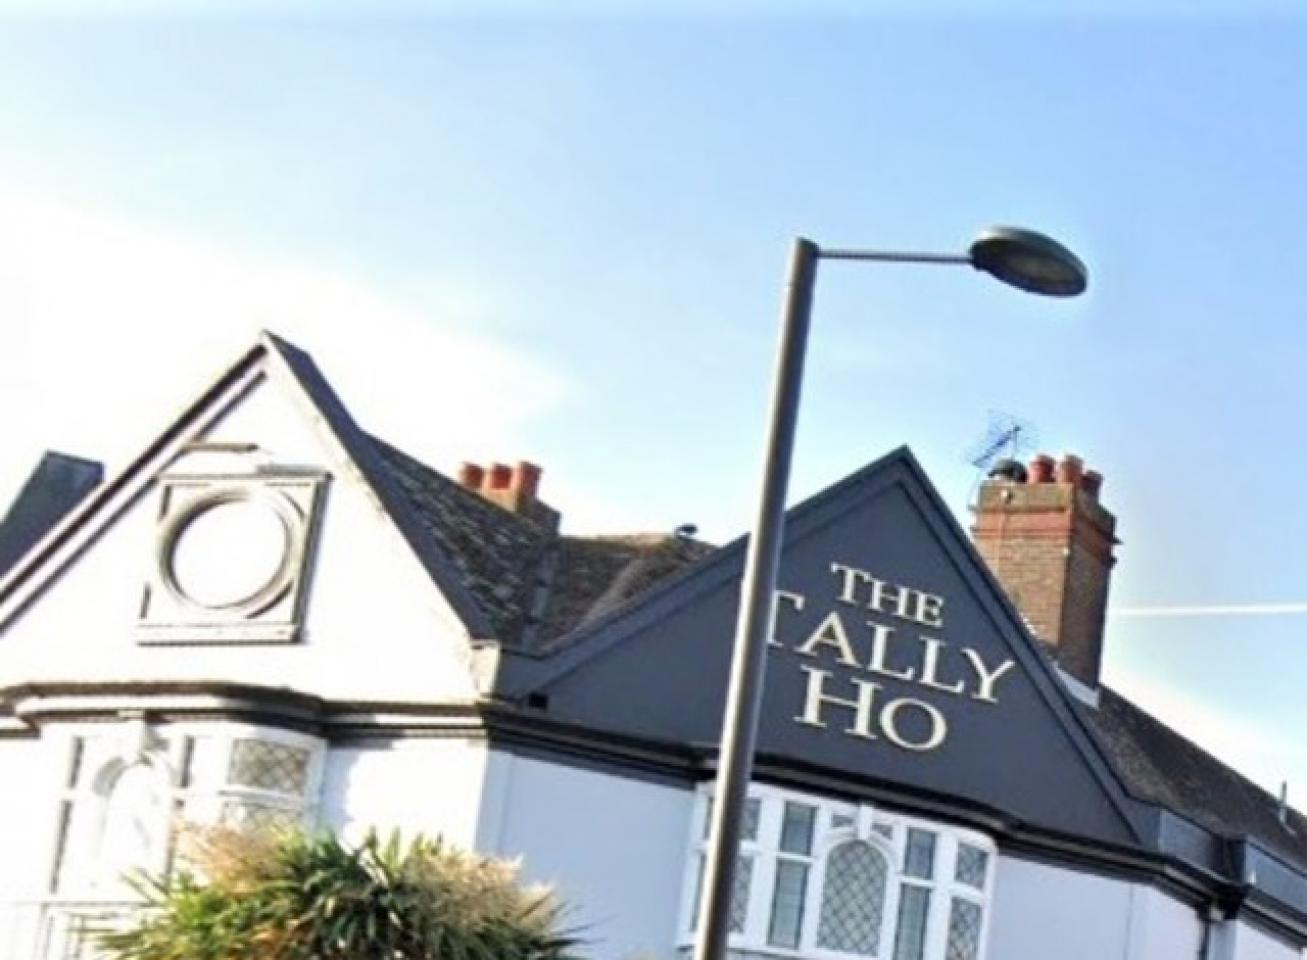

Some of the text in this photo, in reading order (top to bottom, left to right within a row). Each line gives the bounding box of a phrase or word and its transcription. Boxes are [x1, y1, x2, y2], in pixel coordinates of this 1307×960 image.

[830, 562, 945, 628] THE
[767, 589, 1016, 704] TALLY
[794, 663, 948, 752] HO
